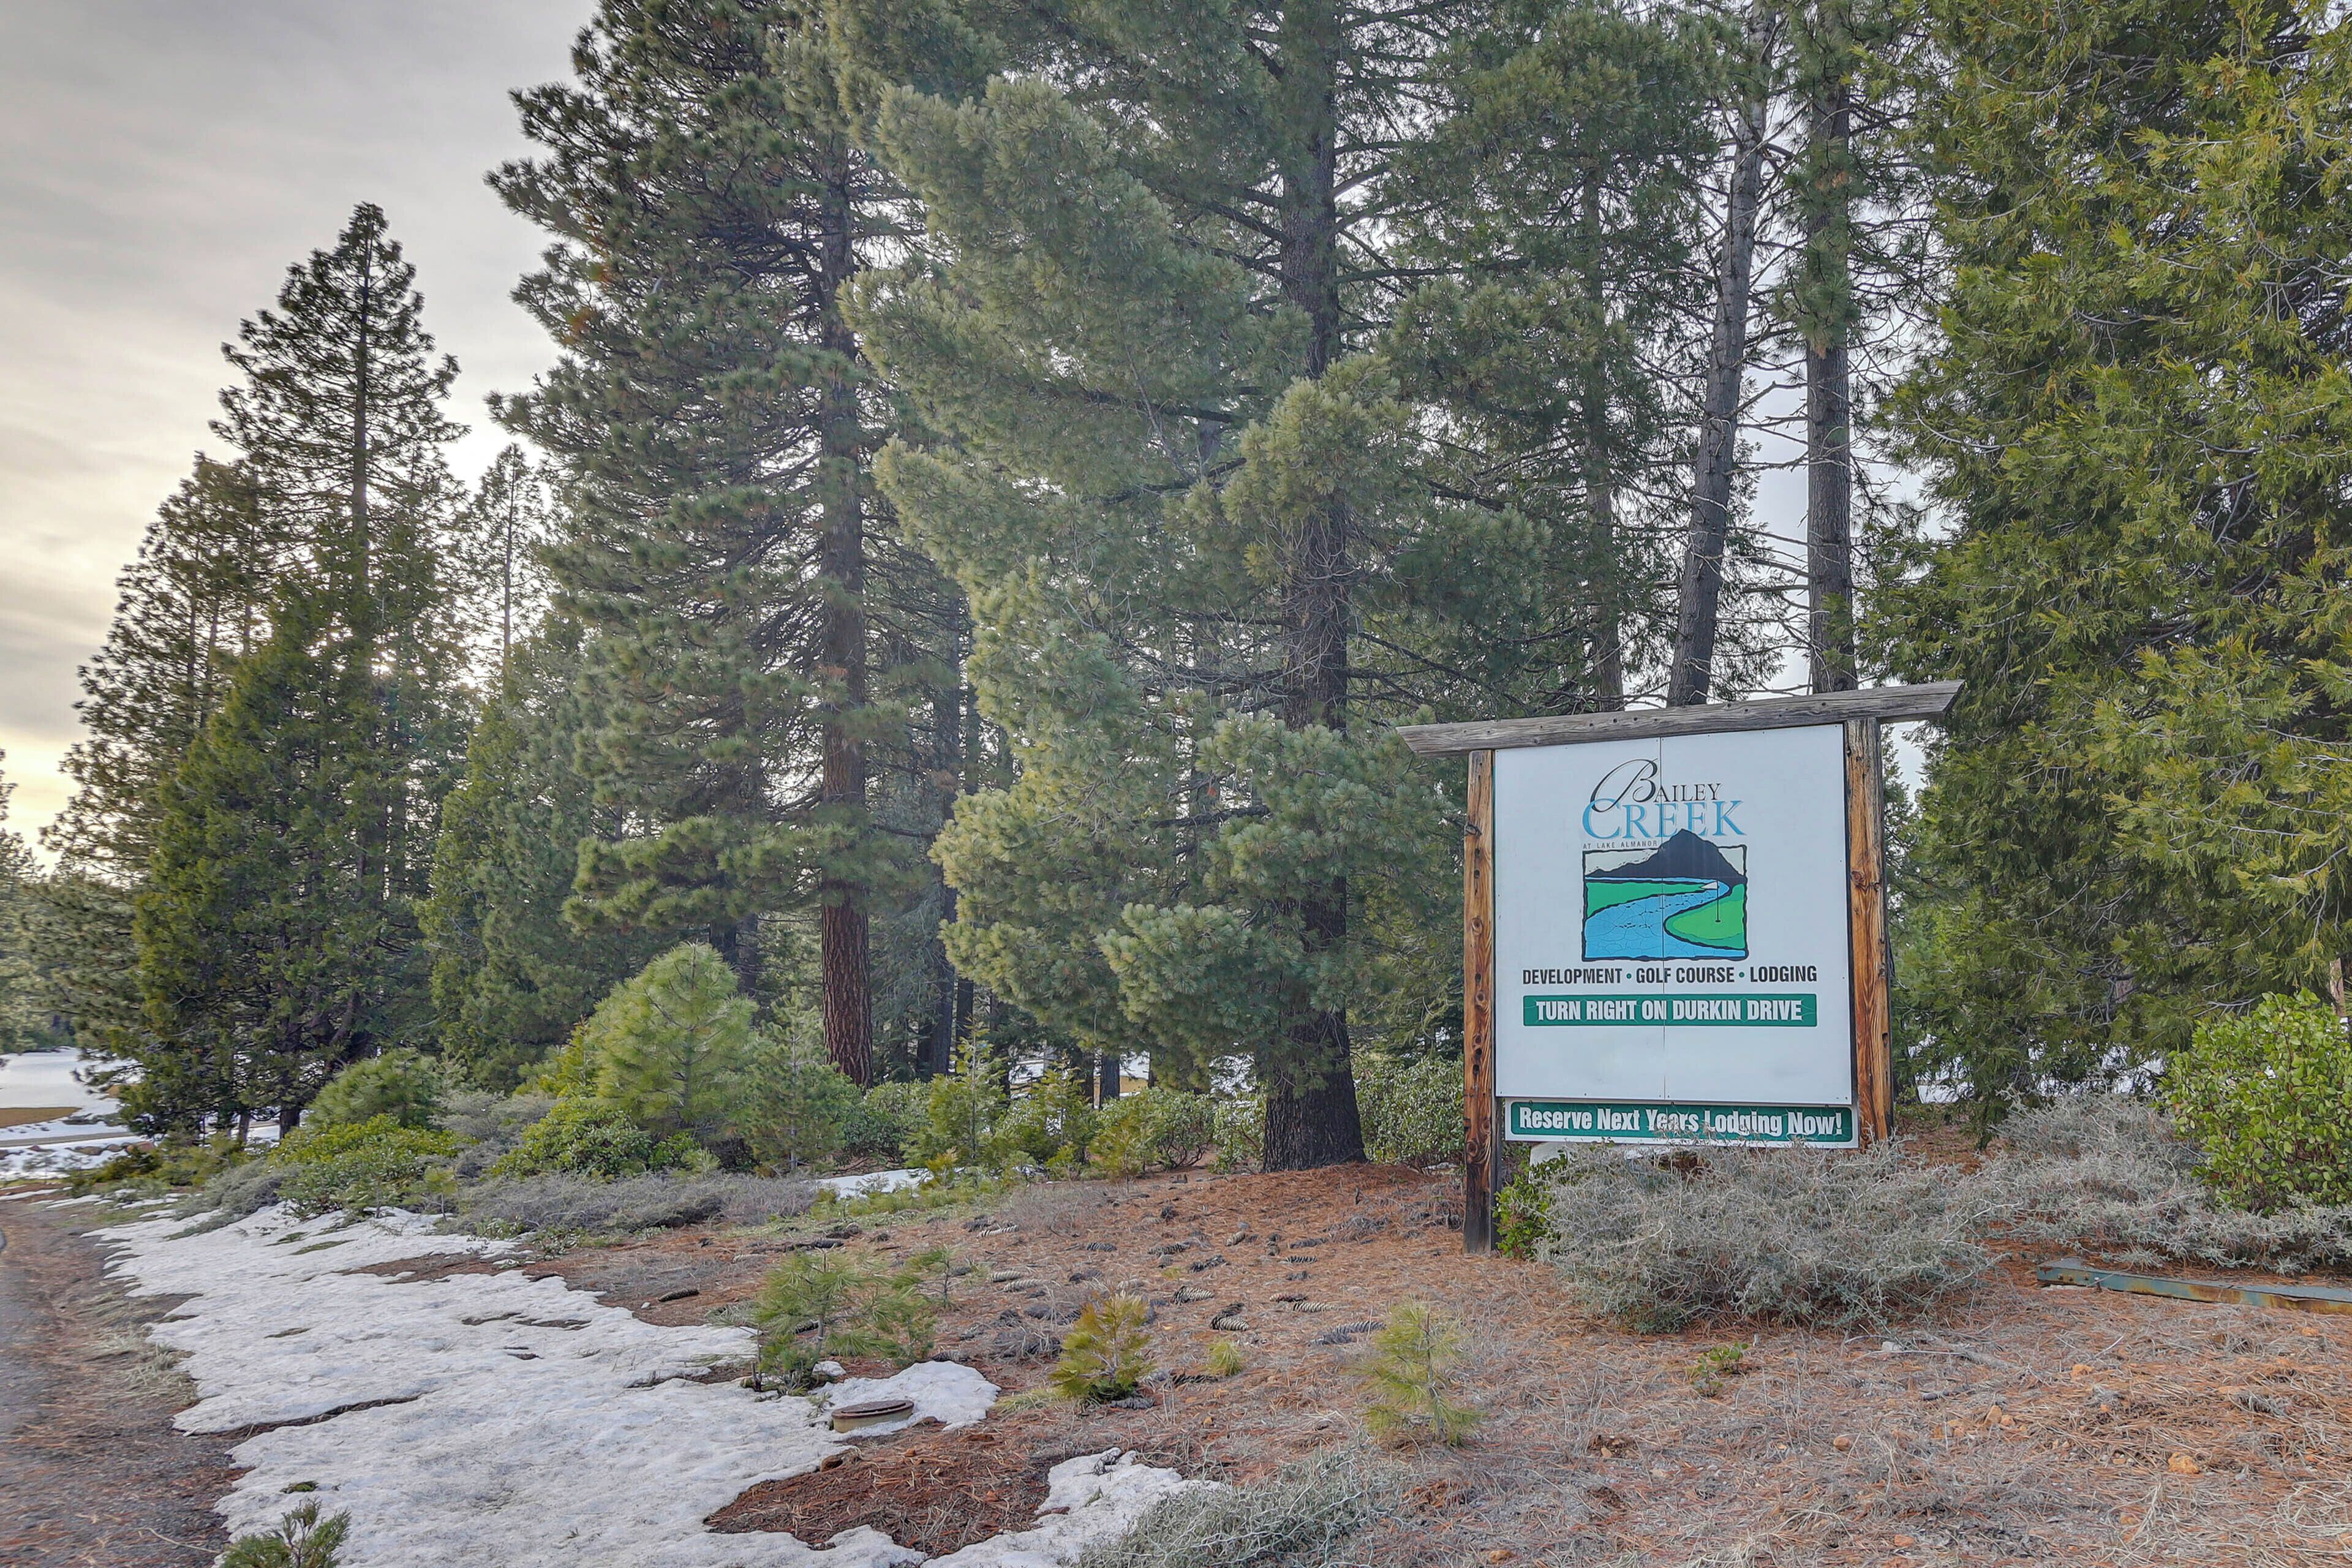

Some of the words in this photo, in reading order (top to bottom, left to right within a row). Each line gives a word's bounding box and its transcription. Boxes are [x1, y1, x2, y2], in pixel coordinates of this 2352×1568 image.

[1590, 758, 1722, 812] BAILEY
[1582, 798, 1746, 839] CREEK
[1523, 968, 1623, 984] DEVELOPMENT
[1636, 968, 1672, 983] GOLF
[1676, 967, 1735, 983] COURSE
[1750, 966, 1817, 982] LODGING
[1536, 1000, 1581, 1020] TURN
[1586, 1000, 1637, 1020] RIGHT
[1642, 1000, 1667, 1020] ON
[1672, 1000, 1741, 1020] DURKIN
[1747, 1000, 1803, 1020] DRIVE
[1519, 1107, 1593, 1129] Reserve
[1597, 1108, 1640, 1131] Next
[1646, 1109, 1700, 1133] Years
[1703, 1110, 1783, 1137] Lodging
[1787, 1112, 1842, 1135] Now!
